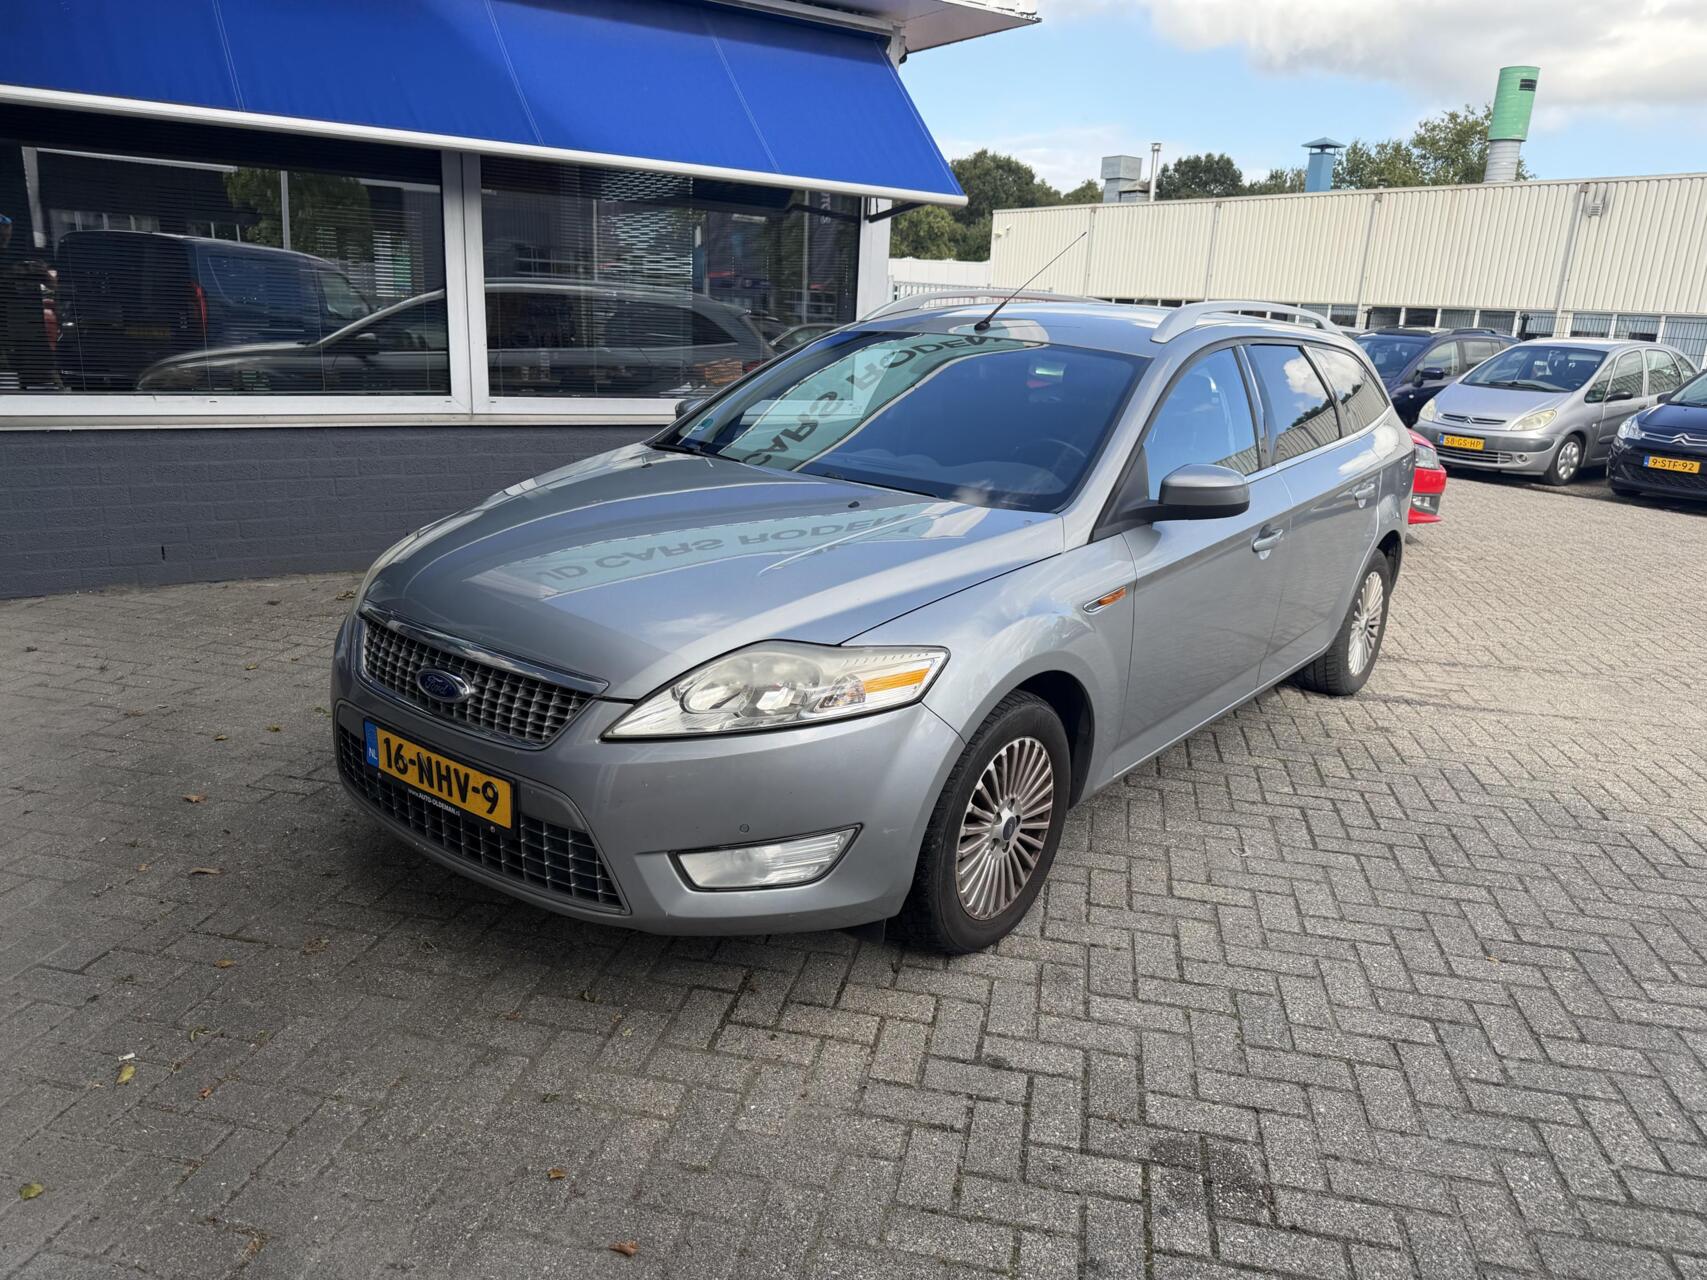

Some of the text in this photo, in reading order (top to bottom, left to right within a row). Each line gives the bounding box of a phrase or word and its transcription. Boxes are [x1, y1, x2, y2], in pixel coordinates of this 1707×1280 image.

[1652, 458, 1695, 471] 9-STF-92
[368, 737, 499, 815] NL 16-NHV-9
